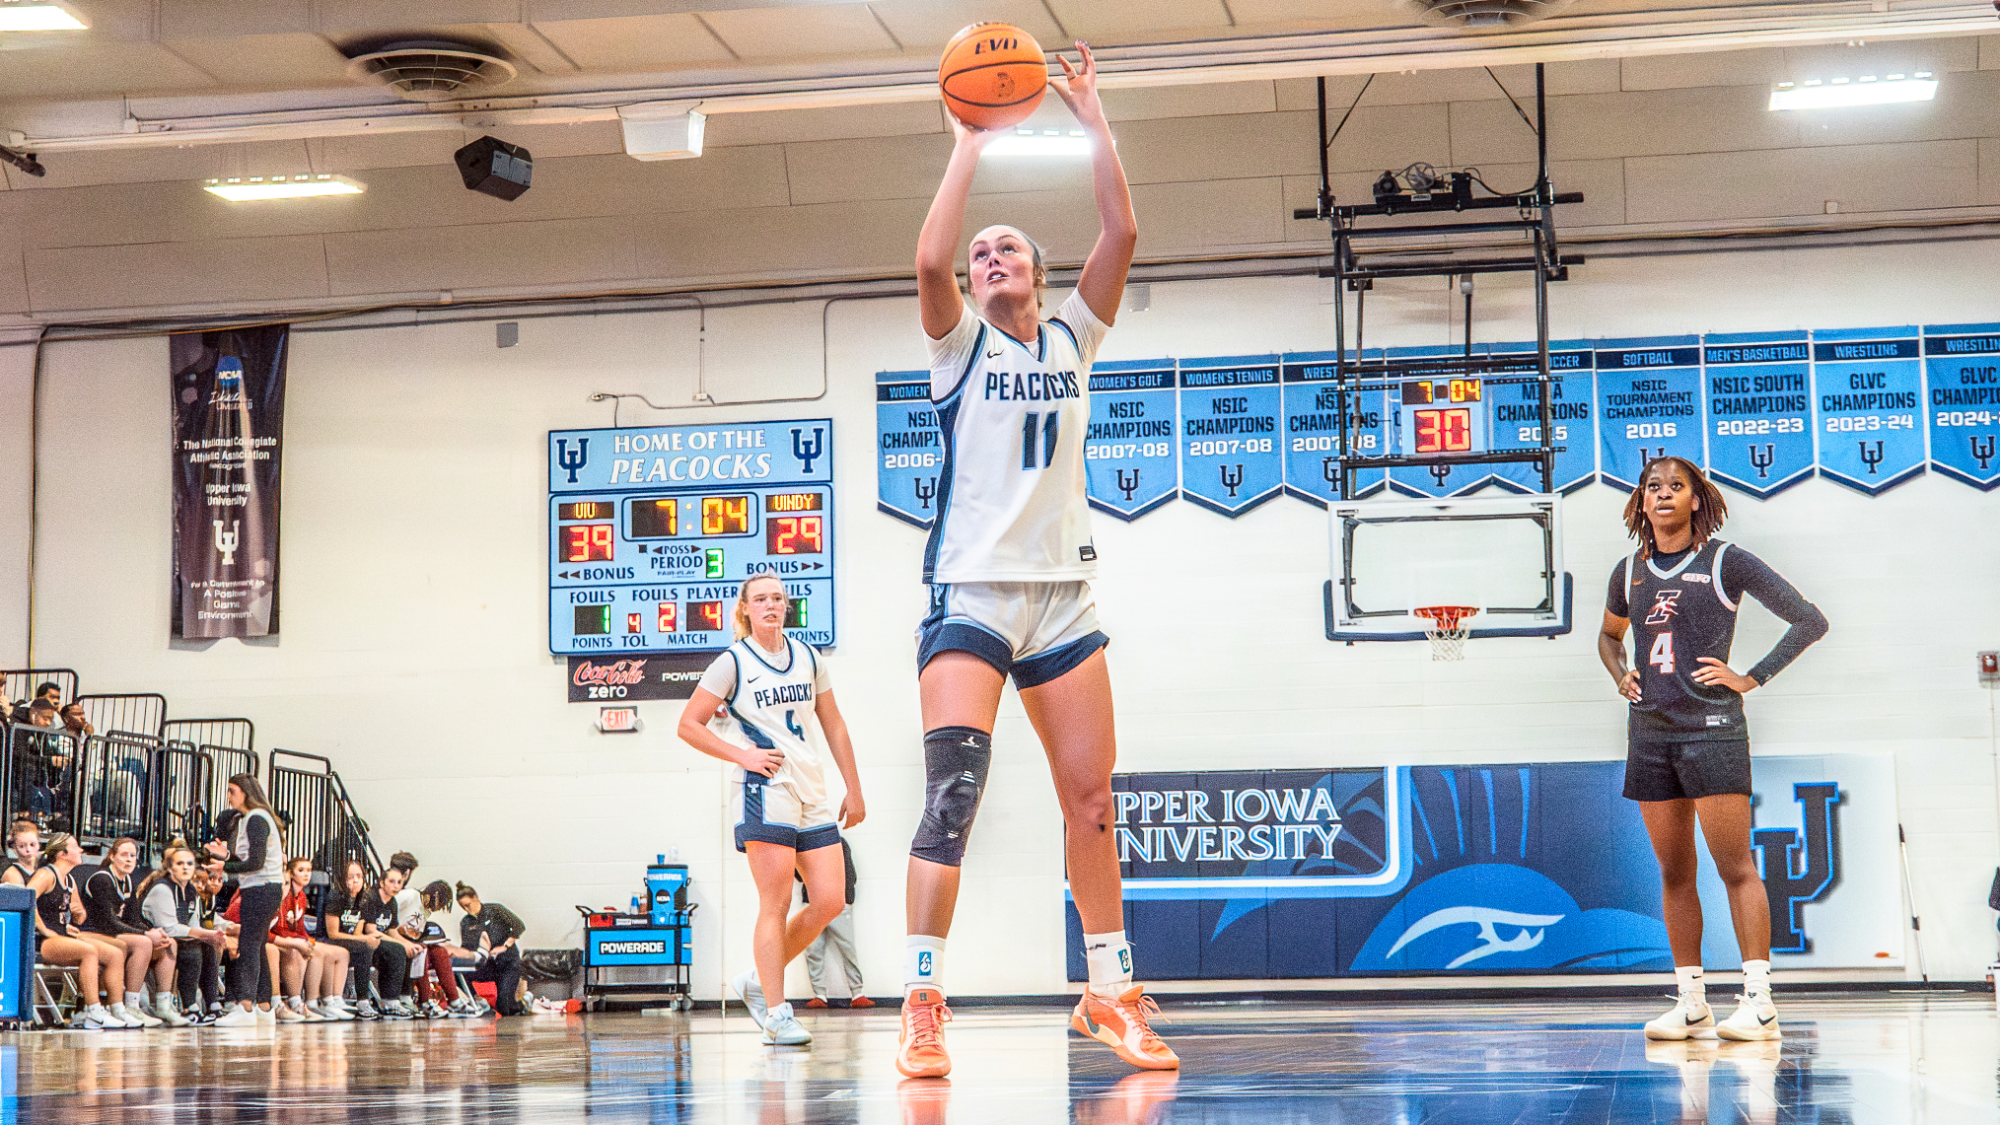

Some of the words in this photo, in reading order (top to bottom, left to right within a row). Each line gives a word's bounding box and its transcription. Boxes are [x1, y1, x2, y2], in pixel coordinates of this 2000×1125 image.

[1707, 349, 1741, 362] MEN'S
[1742, 345, 1807, 361] BASKETBALL
[1834, 343, 1898, 358] WRESTLING
[1946, 338, 2000, 352] WRESTLIN
[1549, 355, 1580, 367] OCCER
[1623, 352, 1674, 366] SOFTBALL
[1089, 375, 1136, 389] WOMEN'S
[1138, 374, 1163, 387] GOLF
[1186, 371, 1234, 386] WOMEN'S
[1236, 369, 1273, 383] TENNIS
[1712, 376, 1750, 394] NSIC
[1754, 373, 1804, 392] SOUTH
[1850, 372, 1886, 389] GLVC
[1960, 367, 1997, 384] GLVC
[888, 385, 931, 398] WOMEN'
[985, 371, 1079, 401] PEACOCKS
[1632, 380, 1667, 391] NSIC
[1606, 391, 1693, 406] TOURNAMENT
[1713, 395, 1806, 415] CHAMPIONS
[1822, 392, 1916, 411] CHAMPIONS
[1933, 388, 2000, 405] CHAMPI
[1109, 401, 1145, 418] NSIC
[1212, 397, 1248, 414] NSIC
[1497, 403, 1588, 421] CHAMIONS
[1606, 404, 1695, 419] CHAMPIONS
[908, 411, 938, 428] NSI
[1187, 416, 1275, 436] CHAMPIONS
[1290, 412, 1378, 432] CHAMPNS
[1717, 418, 1804, 435] 2022-23
[1826, 414, 1914, 432] 2023-24
[1937, 411, 2000, 427] 2024-
[1086, 420, 1171, 440] CHAMPIONS
[1416, 409, 1470, 453] 30
[1519, 426, 1568, 442] 205
[1626, 422, 1677, 439] 2016
[183, 440, 200, 450] The
[201, 437, 233, 449] National
[614, 433, 683, 454] HOME
[688, 431, 718, 450] OF
[722, 429, 766, 449] THE
[883, 431, 940, 449] CHAMPI
[1022, 410, 1059, 471] 11
[1190, 438, 1272, 456] 2007-08
[1086, 443, 1169, 460] 2007-08
[607, 453, 772, 485] PEACOCKS
[885, 453, 942, 469] 2006-
[206, 483, 230, 495] Upper
[207, 495, 247, 507] University
[774, 493, 814, 511] UINDY
[574, 502, 596, 519] UIU
[569, 525, 612, 562] 39
[777, 517, 821, 553] 29
[664, 544, 690, 554] POSS
[651, 556, 703, 569] PERIOD
[708, 549, 723, 578] 3
[746, 561, 798, 575] BONUS
[583, 566, 635, 580] BONUS
[203, 589, 212, 598] A
[570, 590, 615, 604] FOULS
[632, 588, 678, 601] FOULS
[687, 586, 739, 599] PLAYER
[785, 583, 812, 597] ULS
[603, 605, 610, 633] 1
[659, 603, 676, 632] 2
[704, 602, 722, 630] 4
[800, 597, 807, 627] 1
[628, 613, 640, 633] 4
[572, 637, 613, 648] POINTS
[621, 635, 649, 647] TOL
[667, 633, 708, 645] MATCH
[788, 631, 830, 643] POINTS
[1650, 631, 1675, 674] 4
[661, 672, 704, 682] POWER
[588, 685, 628, 699] zero
[606, 710, 629, 729] EXIT
[1112, 789, 1216, 824] PPER
[1220, 788, 1342, 823] IOWA
[1113, 824, 1343, 863] NIVERSITY
[600, 942, 665, 953] POWERADE
